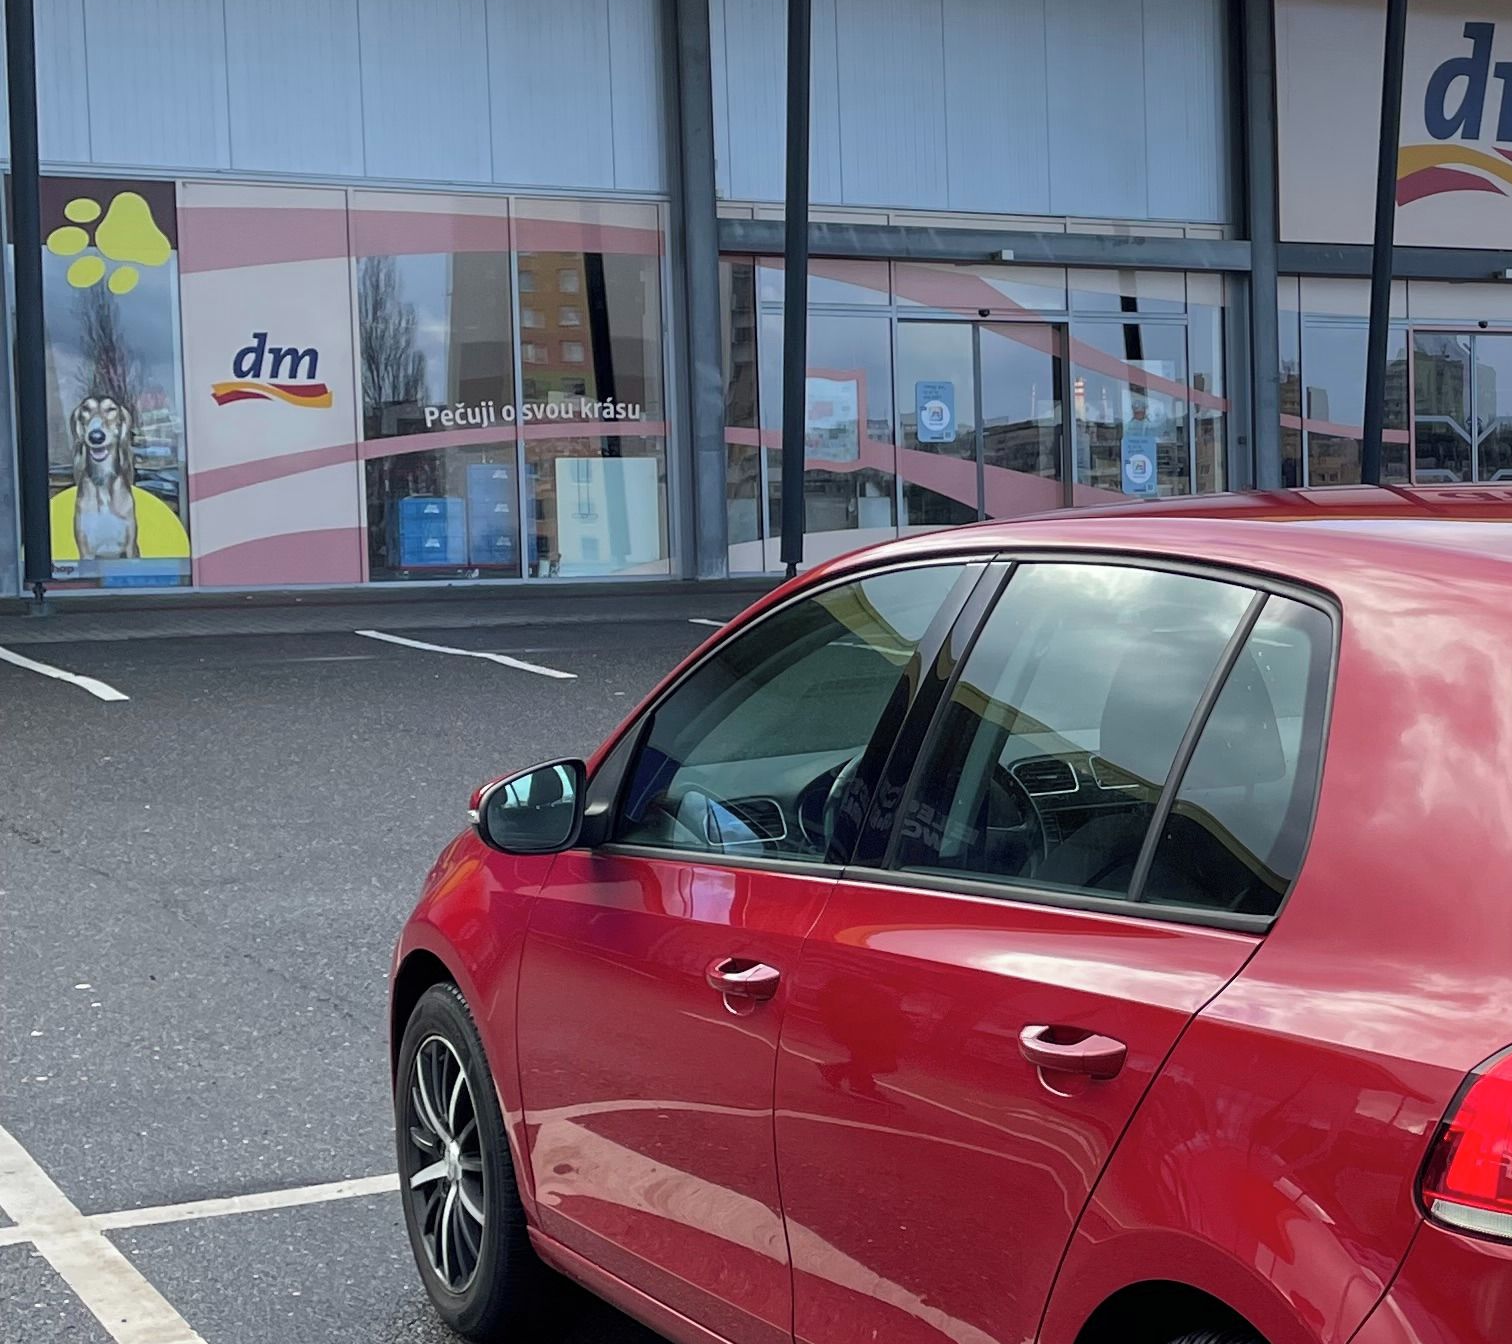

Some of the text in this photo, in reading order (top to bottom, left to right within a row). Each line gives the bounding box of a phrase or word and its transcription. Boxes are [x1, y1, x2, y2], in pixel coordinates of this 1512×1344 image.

[232, 332, 319, 380] dm
[425, 397, 640, 428] Pečuji o svou krásu
